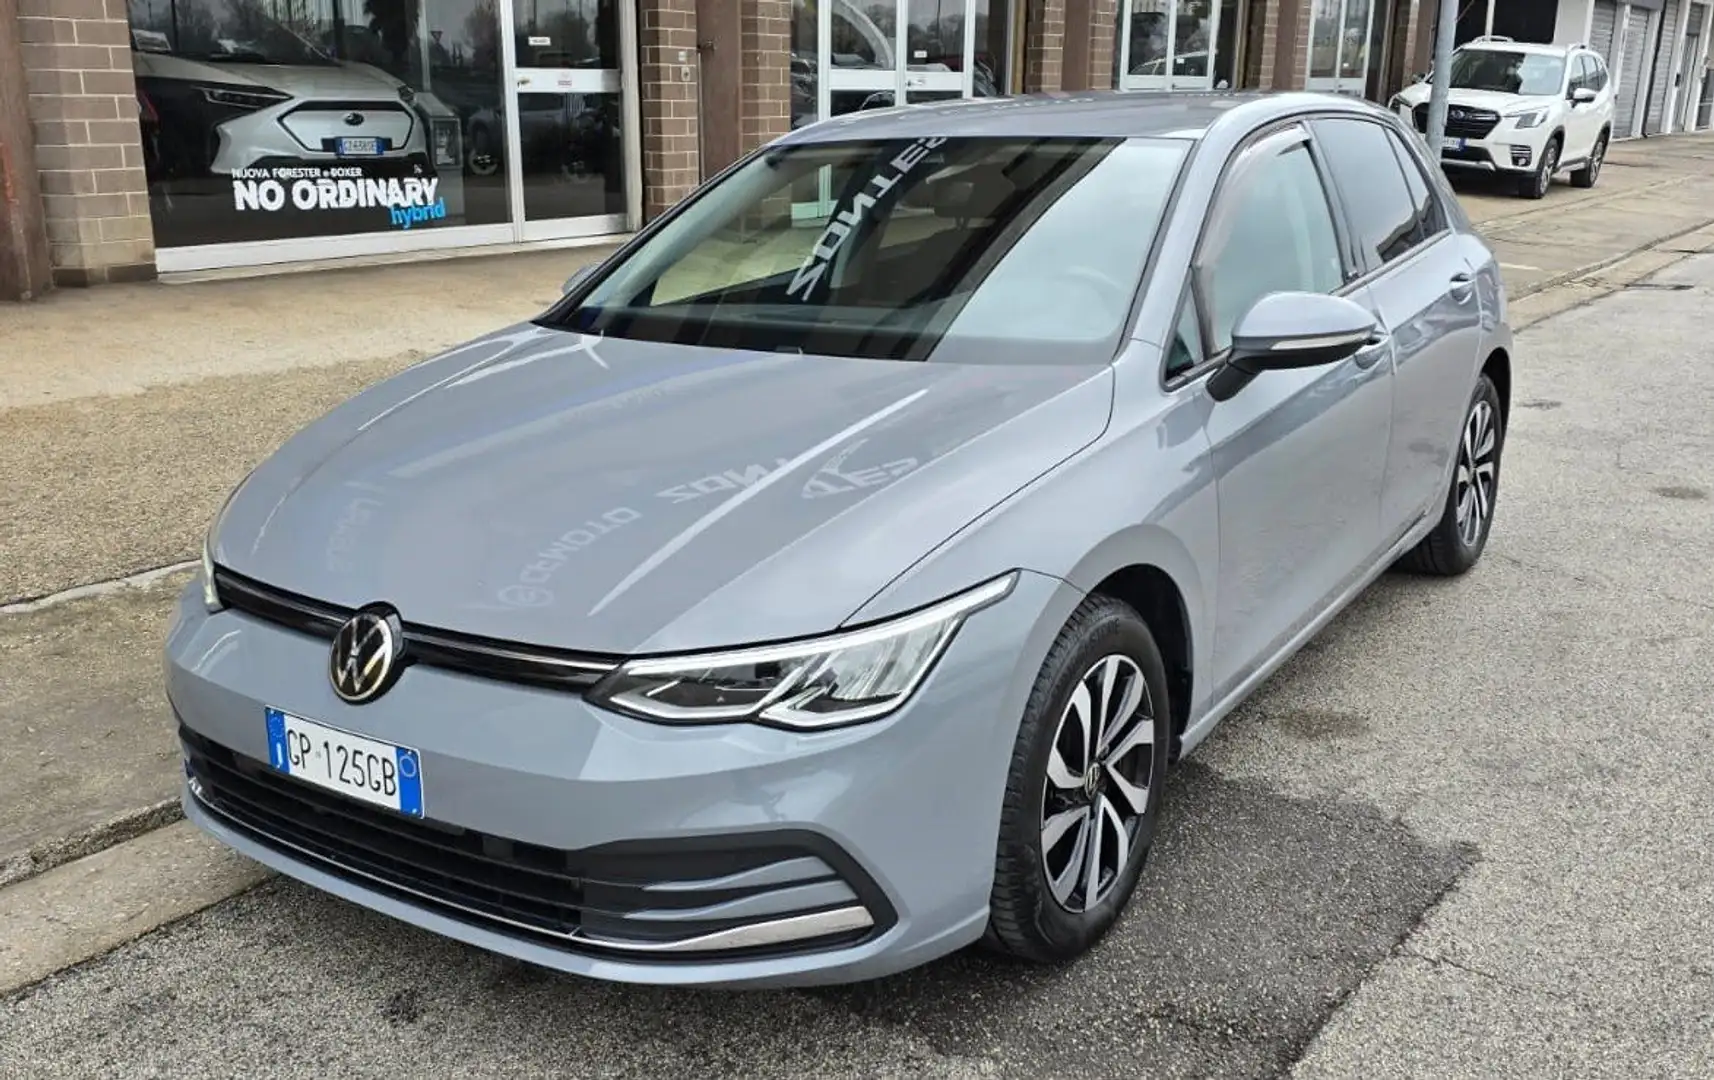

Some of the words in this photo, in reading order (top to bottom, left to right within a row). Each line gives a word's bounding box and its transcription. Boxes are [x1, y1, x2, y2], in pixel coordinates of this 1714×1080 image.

[272, 166, 321, 178] FORESTER
[232, 179, 286, 212] NO
[291, 177, 439, 211] ORDINARY
[389, 197, 447, 229] hybrid
[286, 729, 312, 770] GP
[322, 741, 397, 797] 125GB
